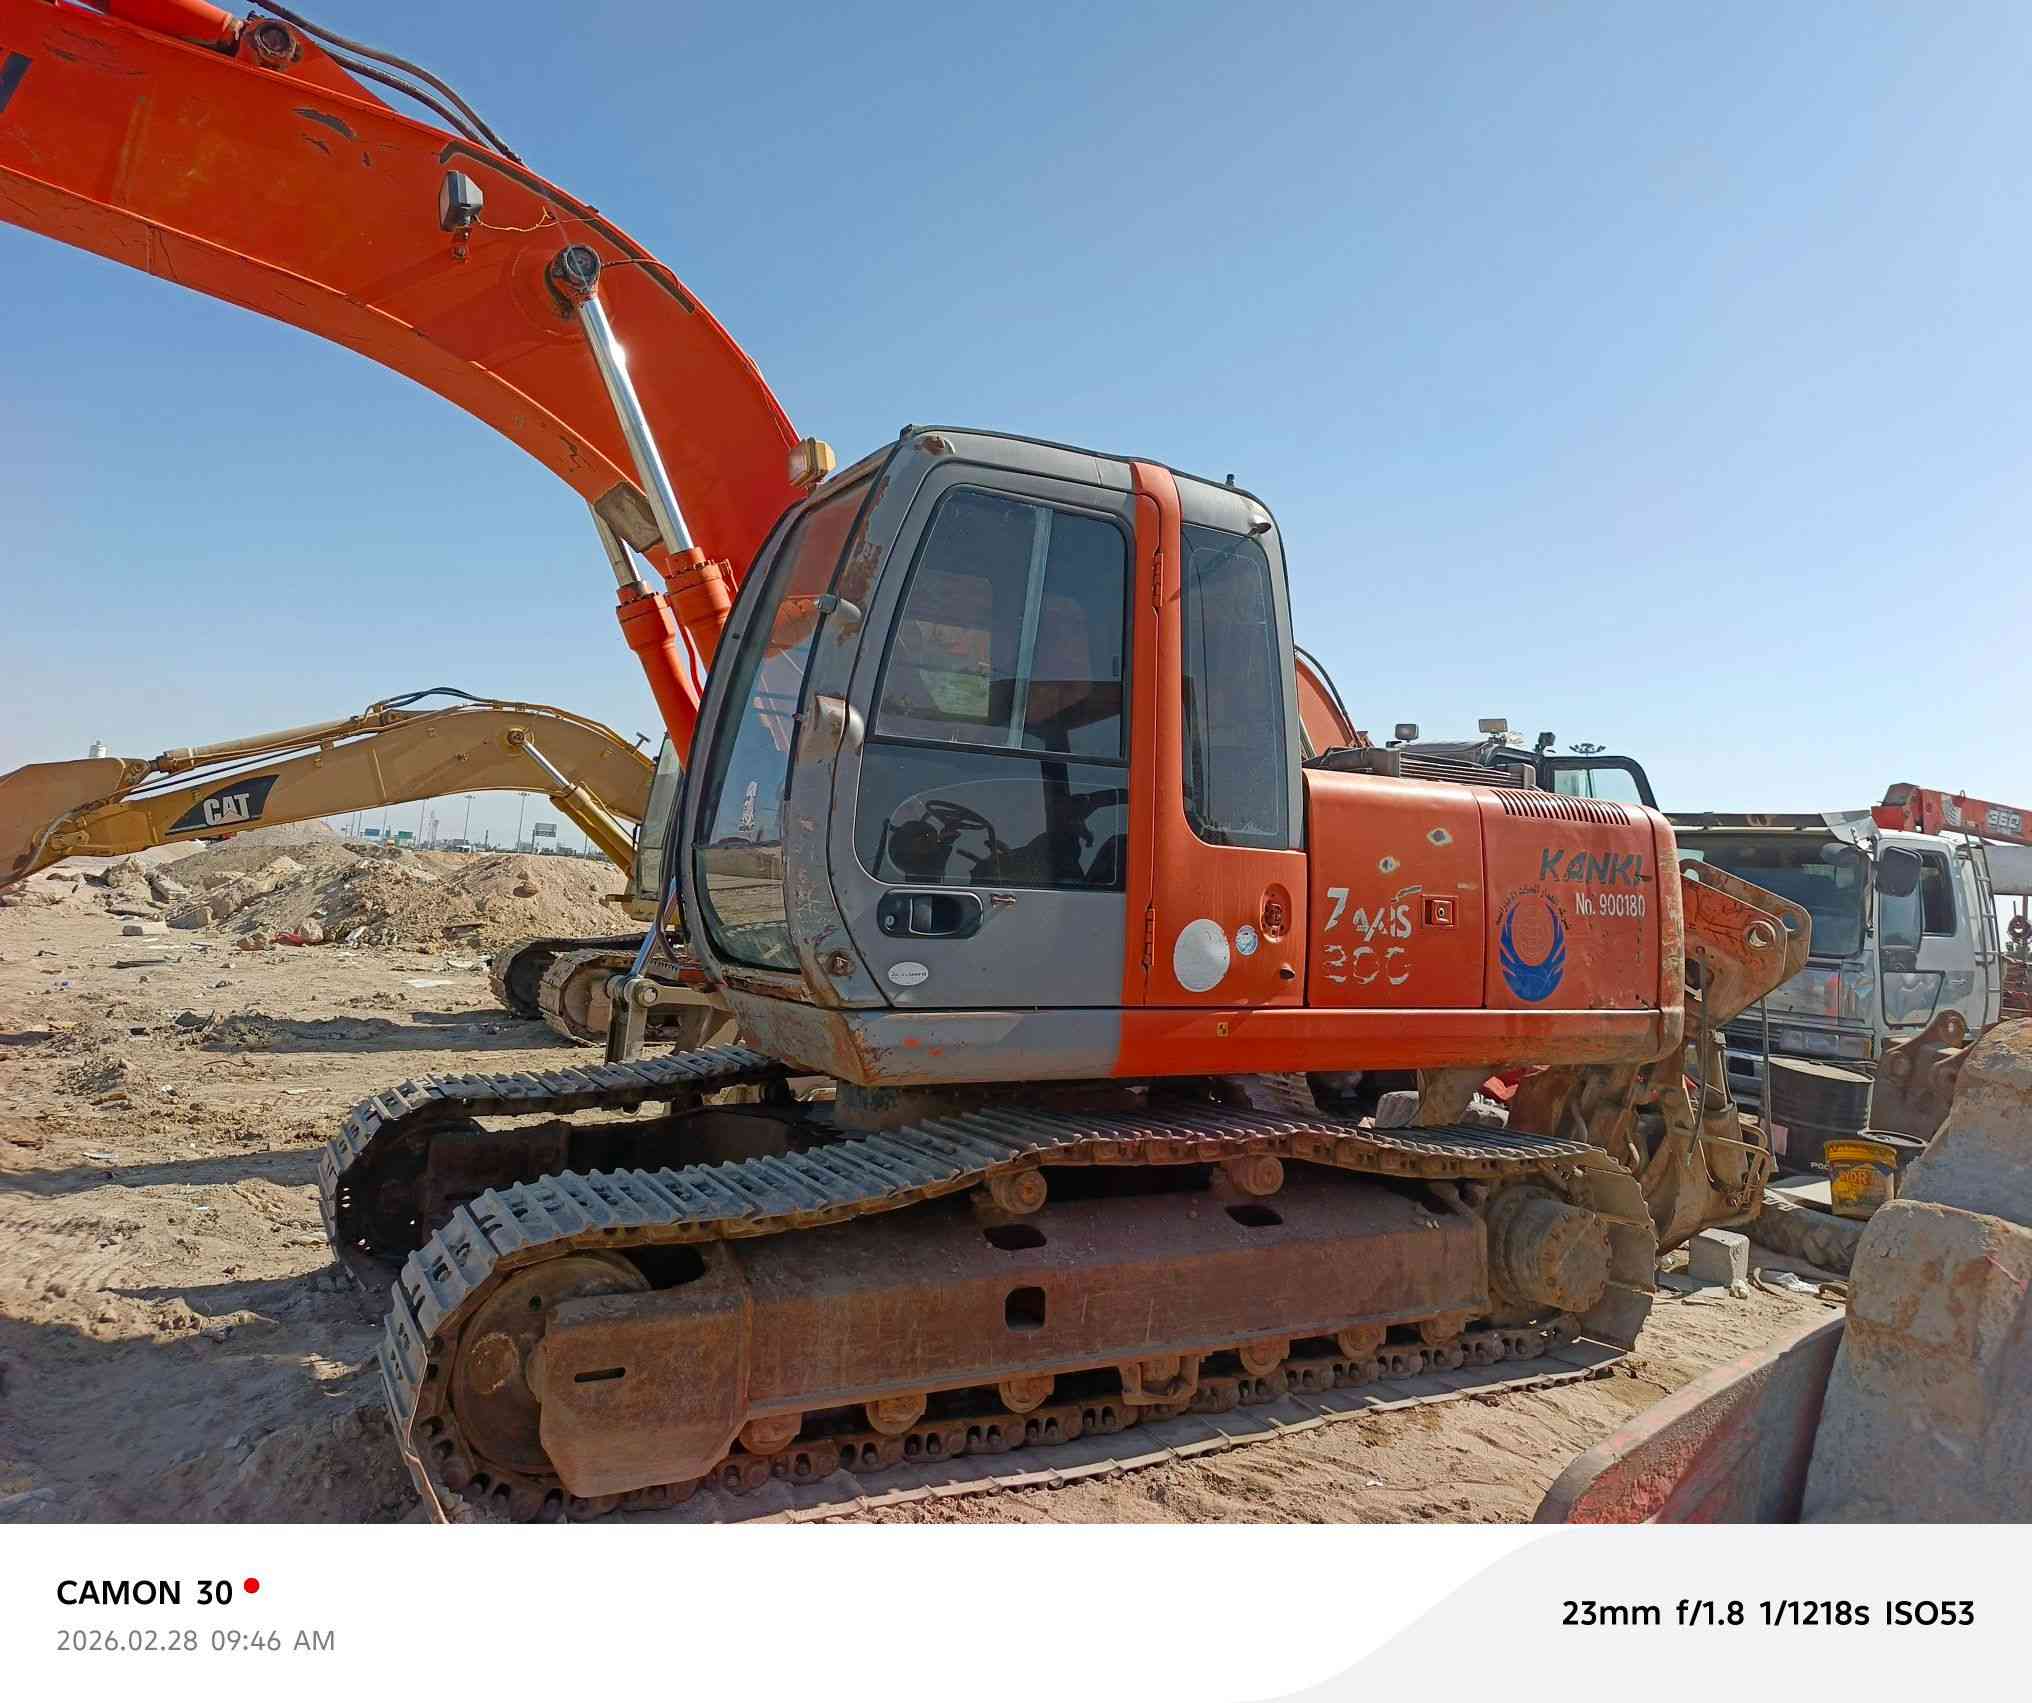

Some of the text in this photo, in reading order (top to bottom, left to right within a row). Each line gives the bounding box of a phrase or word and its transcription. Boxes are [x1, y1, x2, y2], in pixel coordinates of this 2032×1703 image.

[203, 793, 250, 826] CAT
[1576, 892, 1596, 915] No.
[1600, 893, 1645, 917] 900180
